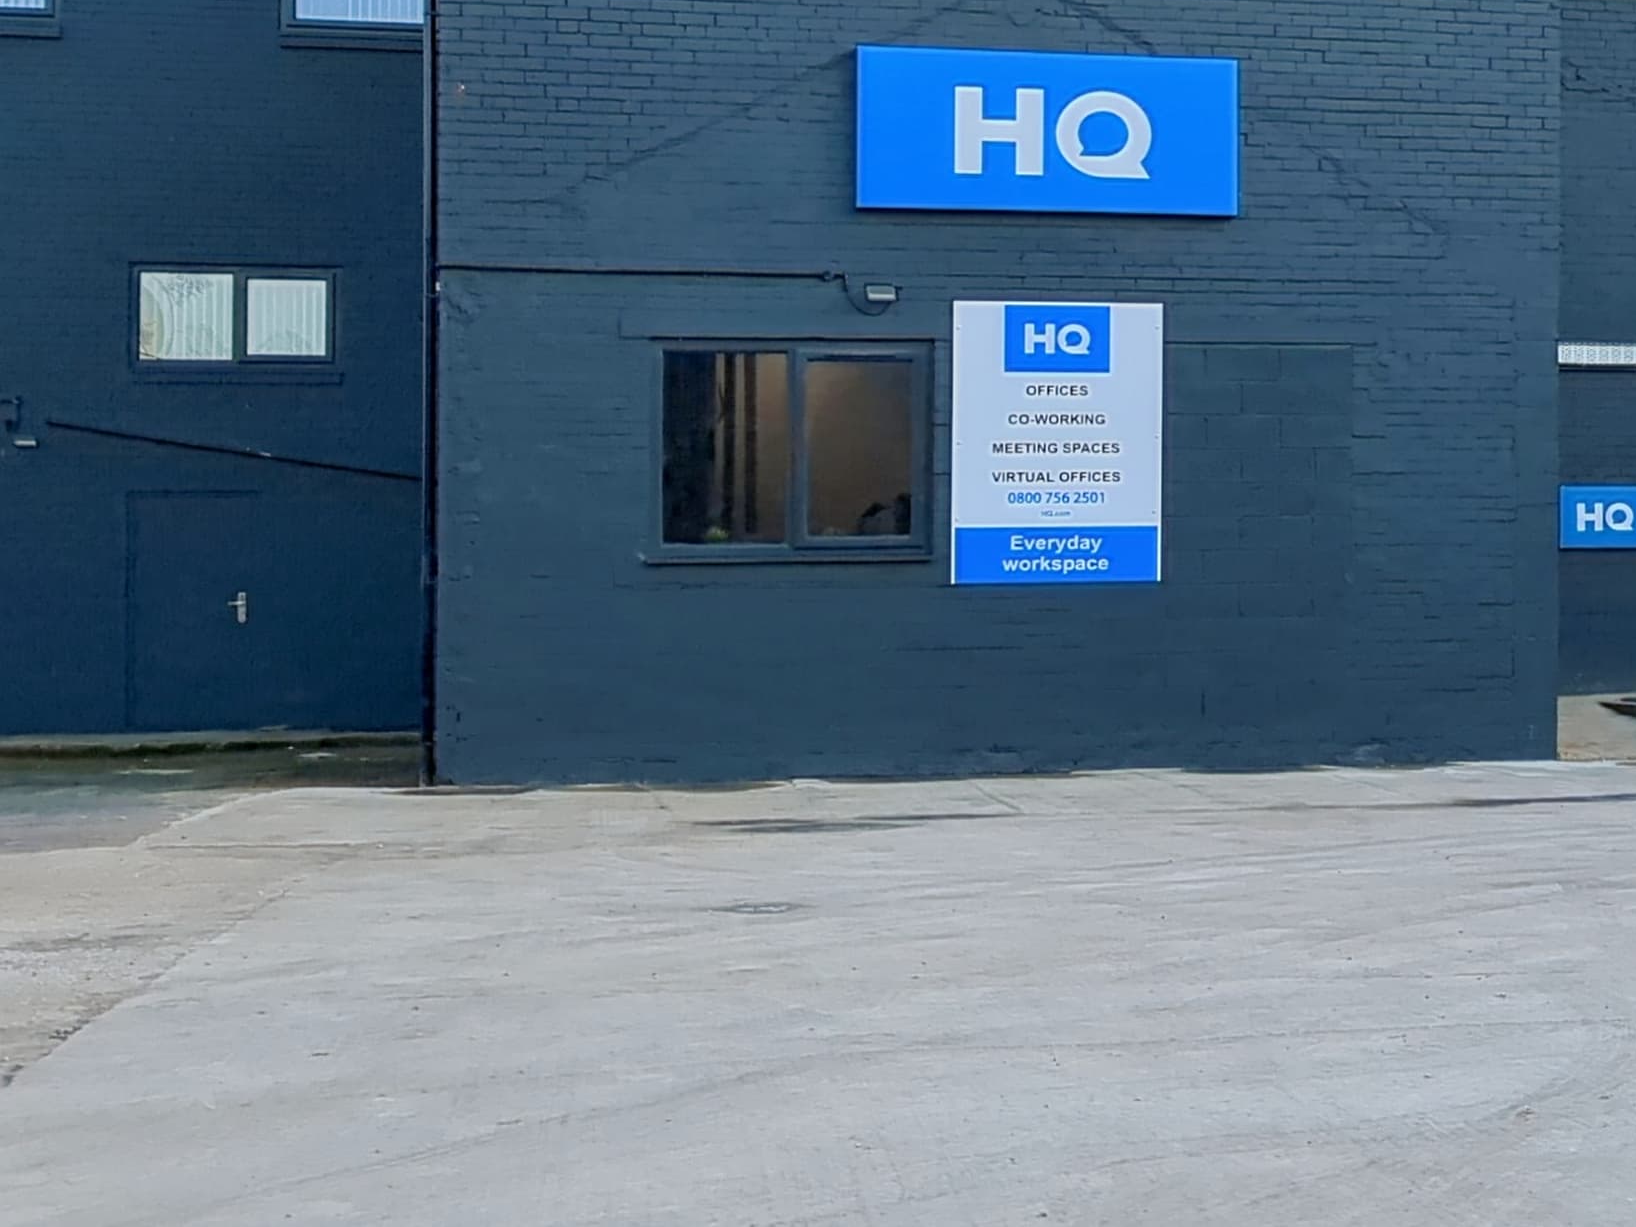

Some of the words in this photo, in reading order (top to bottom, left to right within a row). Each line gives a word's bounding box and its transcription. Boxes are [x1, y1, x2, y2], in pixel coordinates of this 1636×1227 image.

[954, 85, 1152, 179] HQ
[1024, 322, 1091, 355] HQ
[1026, 385, 1088, 396] OFFICES
[1008, 414, 1106, 425] CO-WORKING
[992, 443, 1058, 454] MEETING
[1062, 443, 1120, 454] SPACES
[992, 472, 1054, 483] VIRTUAL
[1059, 472, 1121, 482] OFFICES
[1007, 492, 1042, 504] 0800
[1045, 492, 1070, 504] 756
[1073, 492, 1105, 503] 2501
[1576, 502, 1634, 532] HQ
[1010, 535, 1102, 553] Everyday
[1002, 556, 1109, 573] workspace
